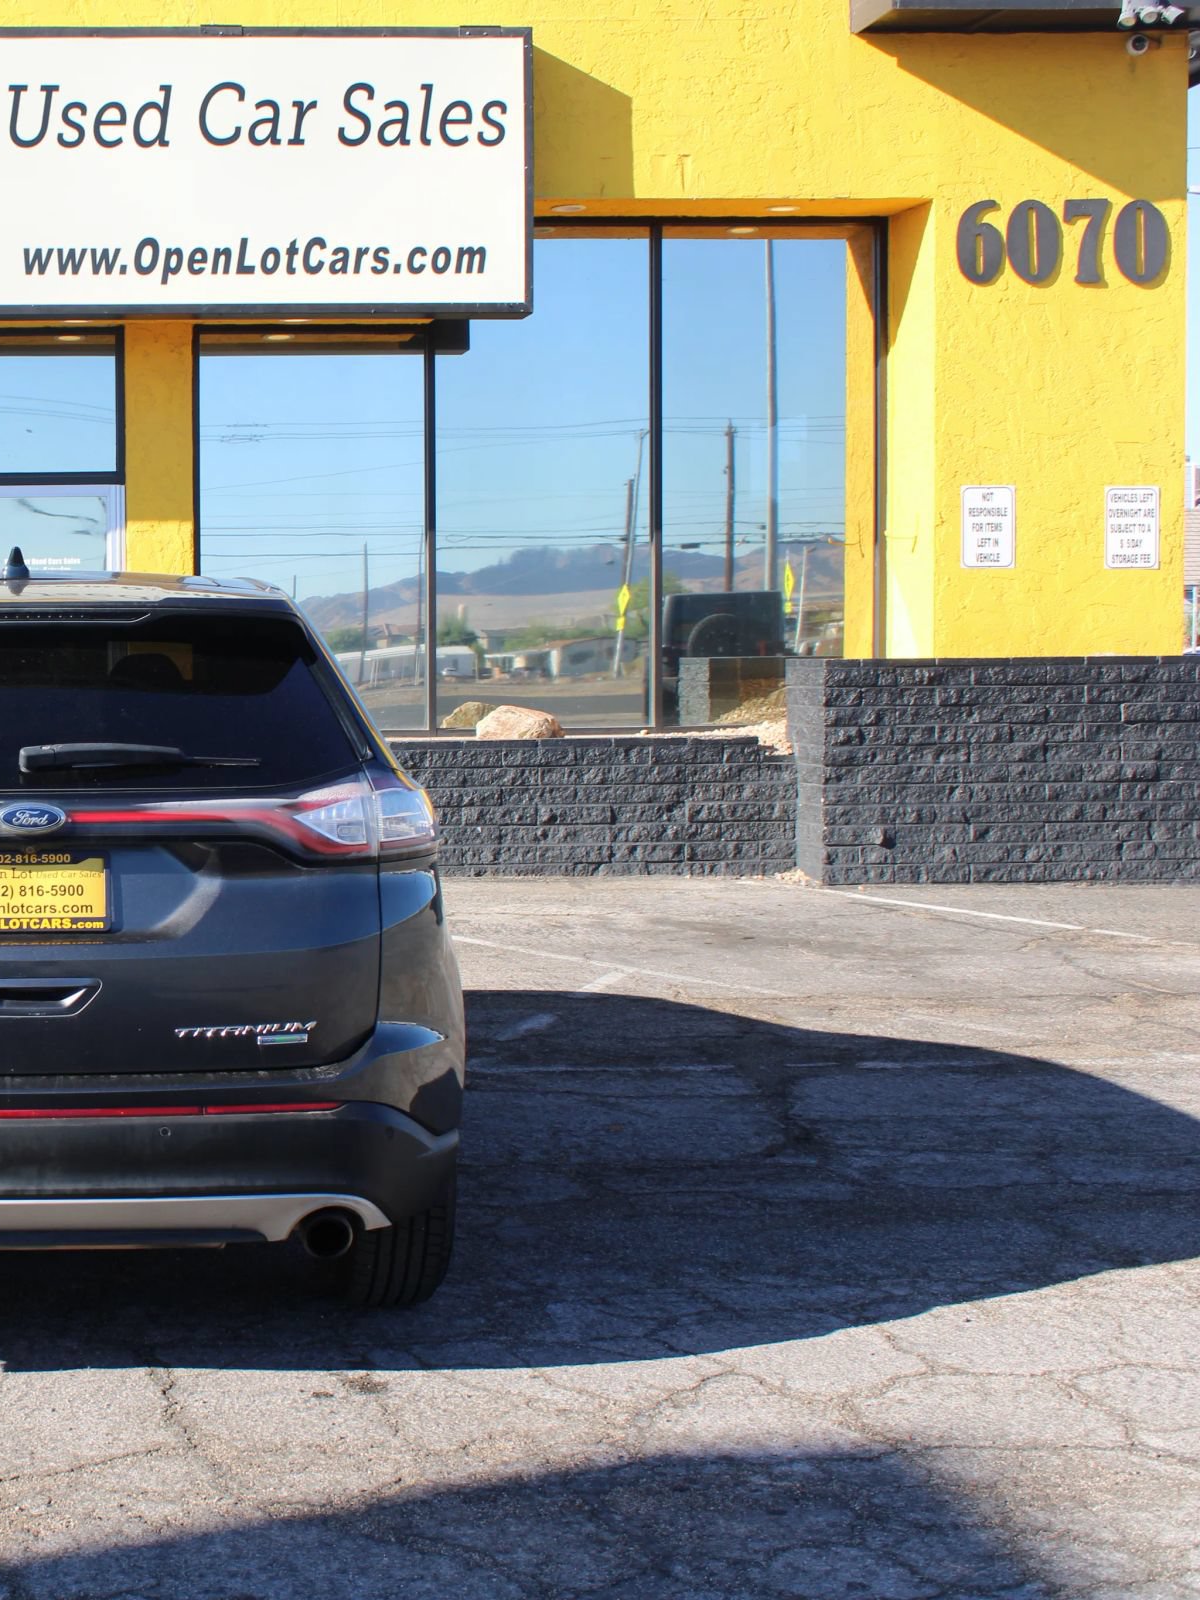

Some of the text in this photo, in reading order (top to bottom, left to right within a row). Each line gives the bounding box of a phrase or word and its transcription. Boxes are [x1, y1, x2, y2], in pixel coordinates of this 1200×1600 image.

[8, 84, 172, 148] Used
[199, 82, 318, 146] Car
[337, 82, 508, 146] Sales
[956, 199, 1170, 286] 6070
[23, 237, 487, 284] www.OpenLotCars.com
[982, 492, 994, 502] NOT
[1110, 493, 1153, 503] VEHICLES LEFT
[968, 507, 1008, 517] RESPONSIBLE
[1109, 508, 1155, 518] OVERNIGHT ARE
[972, 522, 1003, 532] FOR ITEMS
[1110, 524, 1136, 533] SUBJECT
[1137, 524, 1145, 533] TO
[977, 537, 999, 547] LEFT IN
[976, 553, 1000, 562] VEHICLE
[1112, 554, 1151, 564] STORAGE FEE
[12, 810, 48, 825] Ford
[11, 868, 33, 879] Lot
[61, 871, 77, 879] Car
[19, 885, 84, 898] 816-5900
[174, 1021, 318, 1038] TITANIUM
